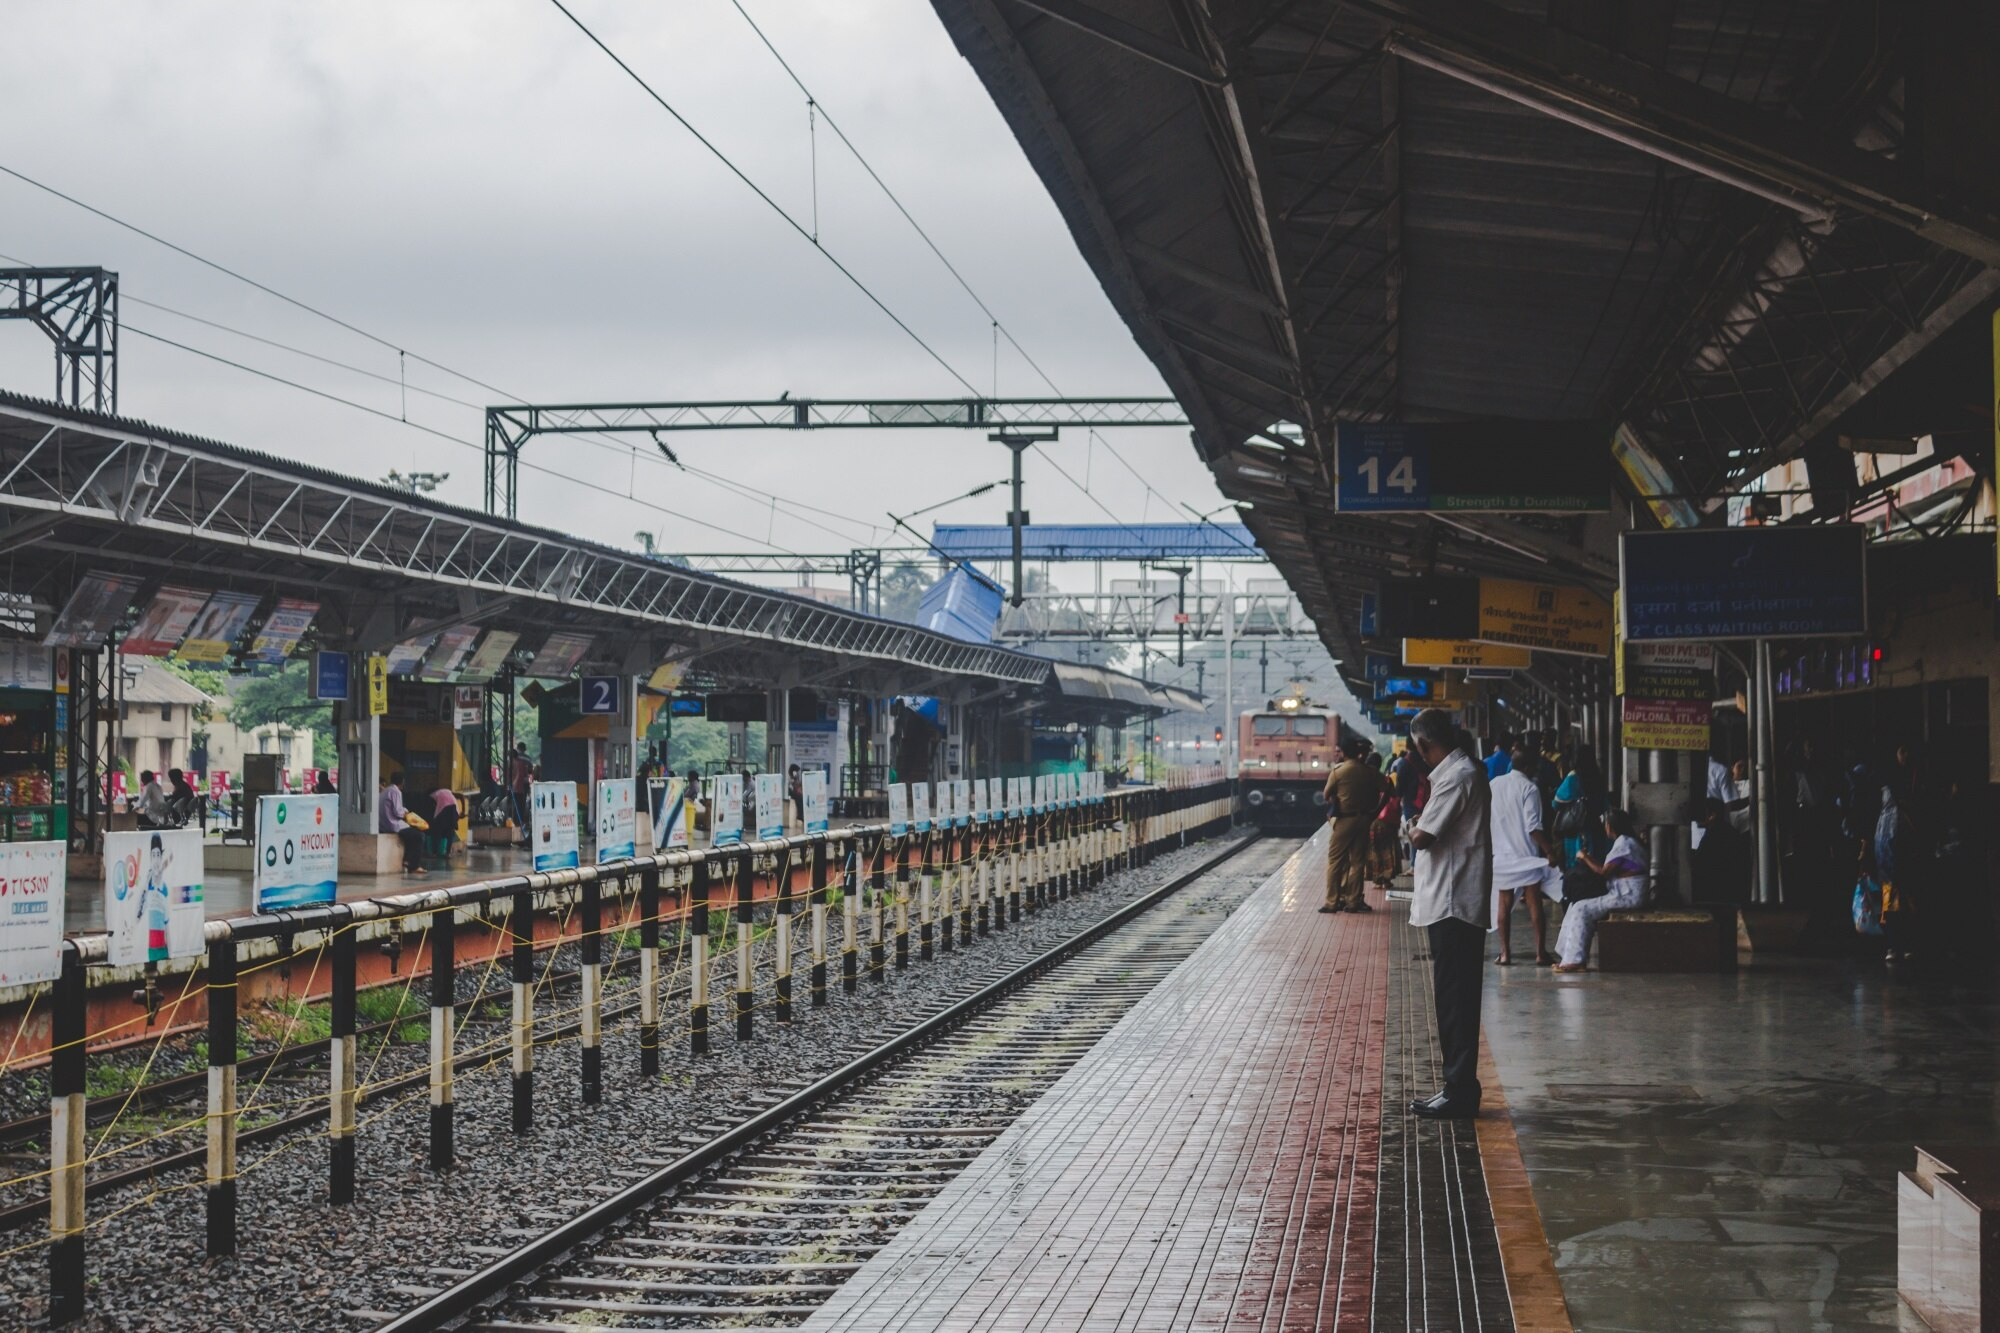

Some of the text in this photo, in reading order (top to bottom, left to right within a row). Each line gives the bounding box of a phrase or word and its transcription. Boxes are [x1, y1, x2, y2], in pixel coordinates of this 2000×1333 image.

[1357, 456, 1417, 494] 14
[1446, 495, 1589, 509] Strength & Durability
[1369, 612, 1378, 628] 1
[1654, 622, 1704, 636] CLASS
[1706, 620, 1774, 634] WAITING
[1778, 619, 1824, 633] ROOM
[1481, 630, 1599, 654] RESERVATION CHARTS
[1452, 656, 1483, 665] EXIT
[1371, 664, 1389, 676] 16
[592, 680, 610, 710] 2
[1625, 711, 1673, 724] DIPLOMA,
[300, 832, 335, 851] HYCOUNT
